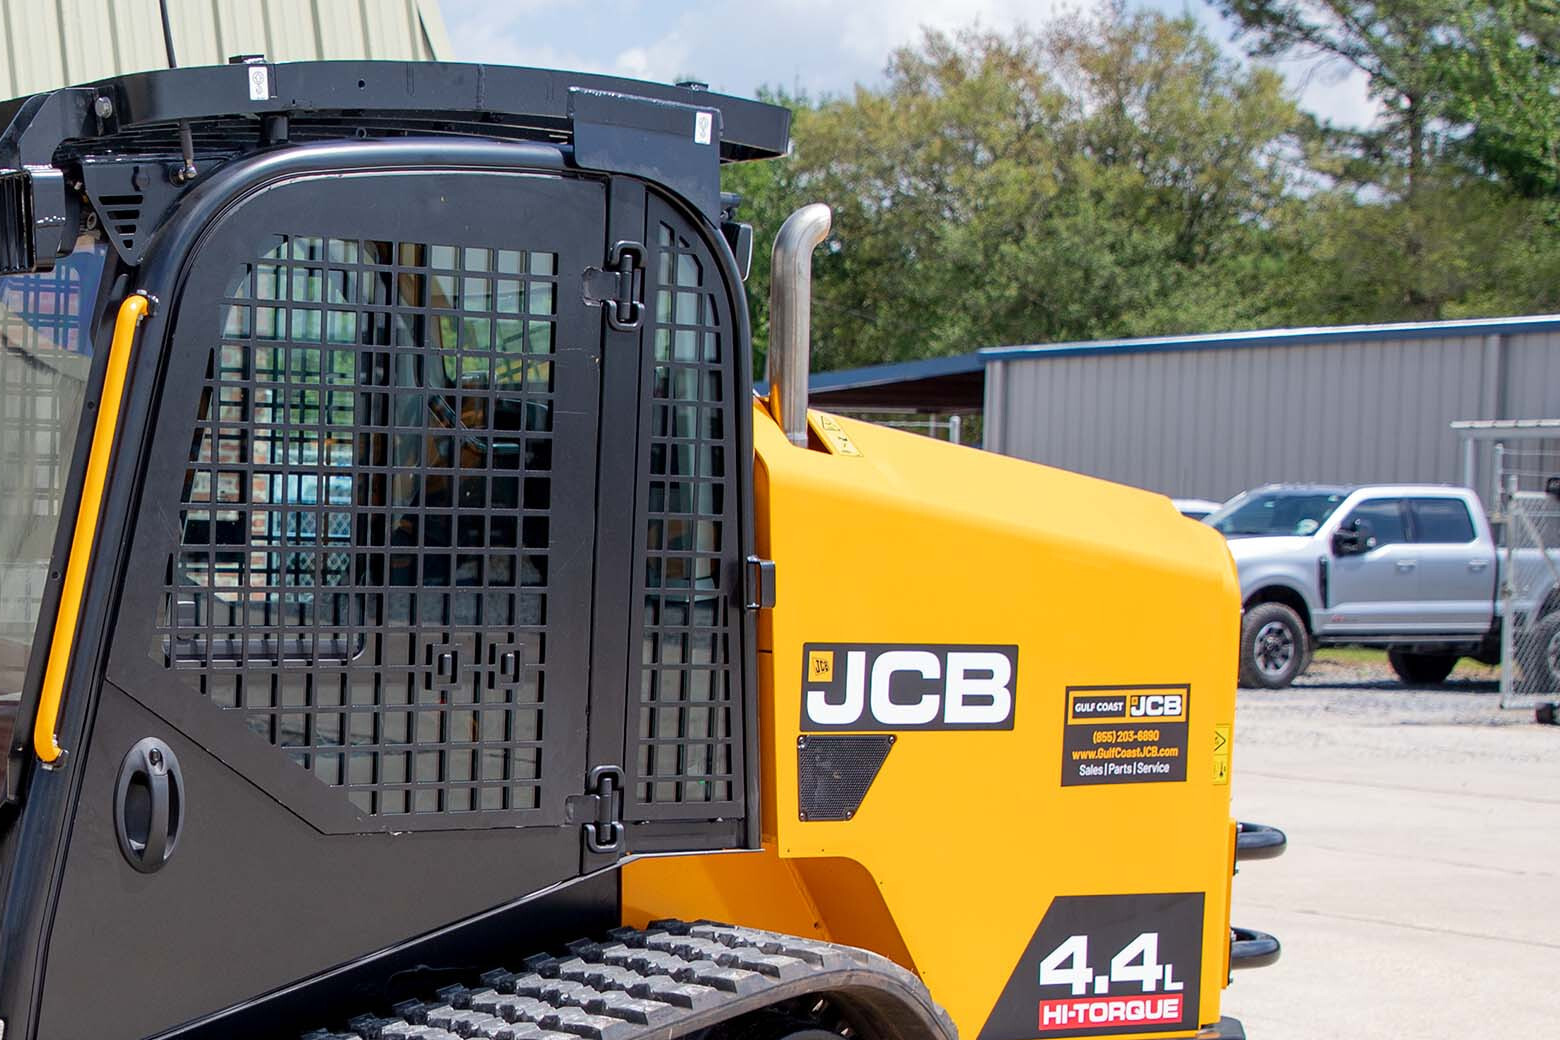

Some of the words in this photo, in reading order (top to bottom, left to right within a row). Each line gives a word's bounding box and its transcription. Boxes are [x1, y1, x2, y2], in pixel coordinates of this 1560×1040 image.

[807, 651, 1011, 724] JCB
[1074, 702, 1095, 713] GULF
[1096, 701, 1124, 712] COAST
[1130, 695, 1182, 716] JCB
[1092, 730, 1116, 744] (855)
[1072, 745, 1179, 760] www.GulfCoastJCB.com
[1079, 763, 1103, 776] Sales
[1108, 762, 1132, 775] Parts
[1136, 761, 1170, 774] Service
[1043, 999, 1179, 1025] HI-TORQUE
